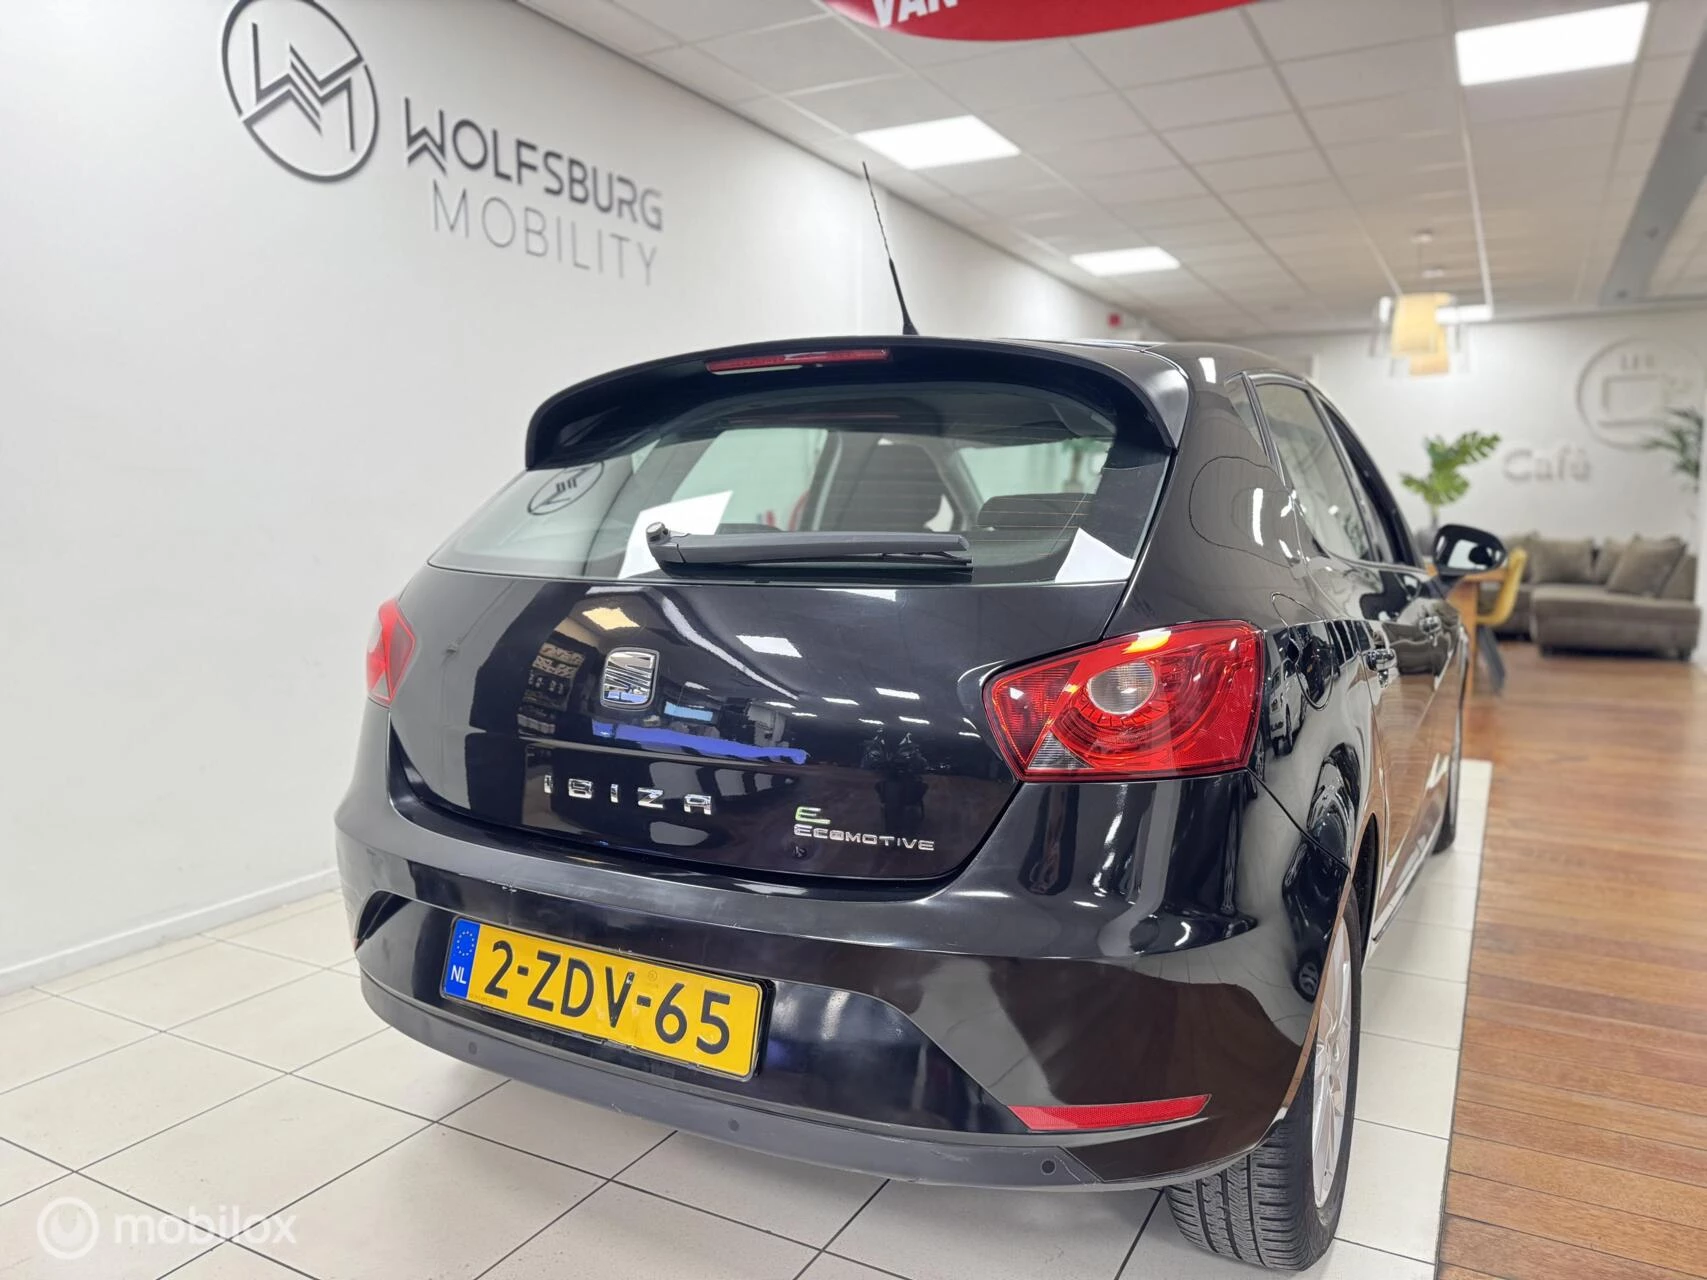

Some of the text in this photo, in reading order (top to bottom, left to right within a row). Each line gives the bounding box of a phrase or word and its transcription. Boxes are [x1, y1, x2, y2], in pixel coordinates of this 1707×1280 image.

[871, 0, 959, 28] VA
[405, 97, 664, 231] WOLFSBURG
[432, 180, 658, 287] MOBILITY
[542, 774, 712, 816] IBIZA
[793, 823, 936, 852] ECOMOTIVE
[450, 964, 467, 985] NL
[484, 940, 731, 1055] 2-ZDV-65
